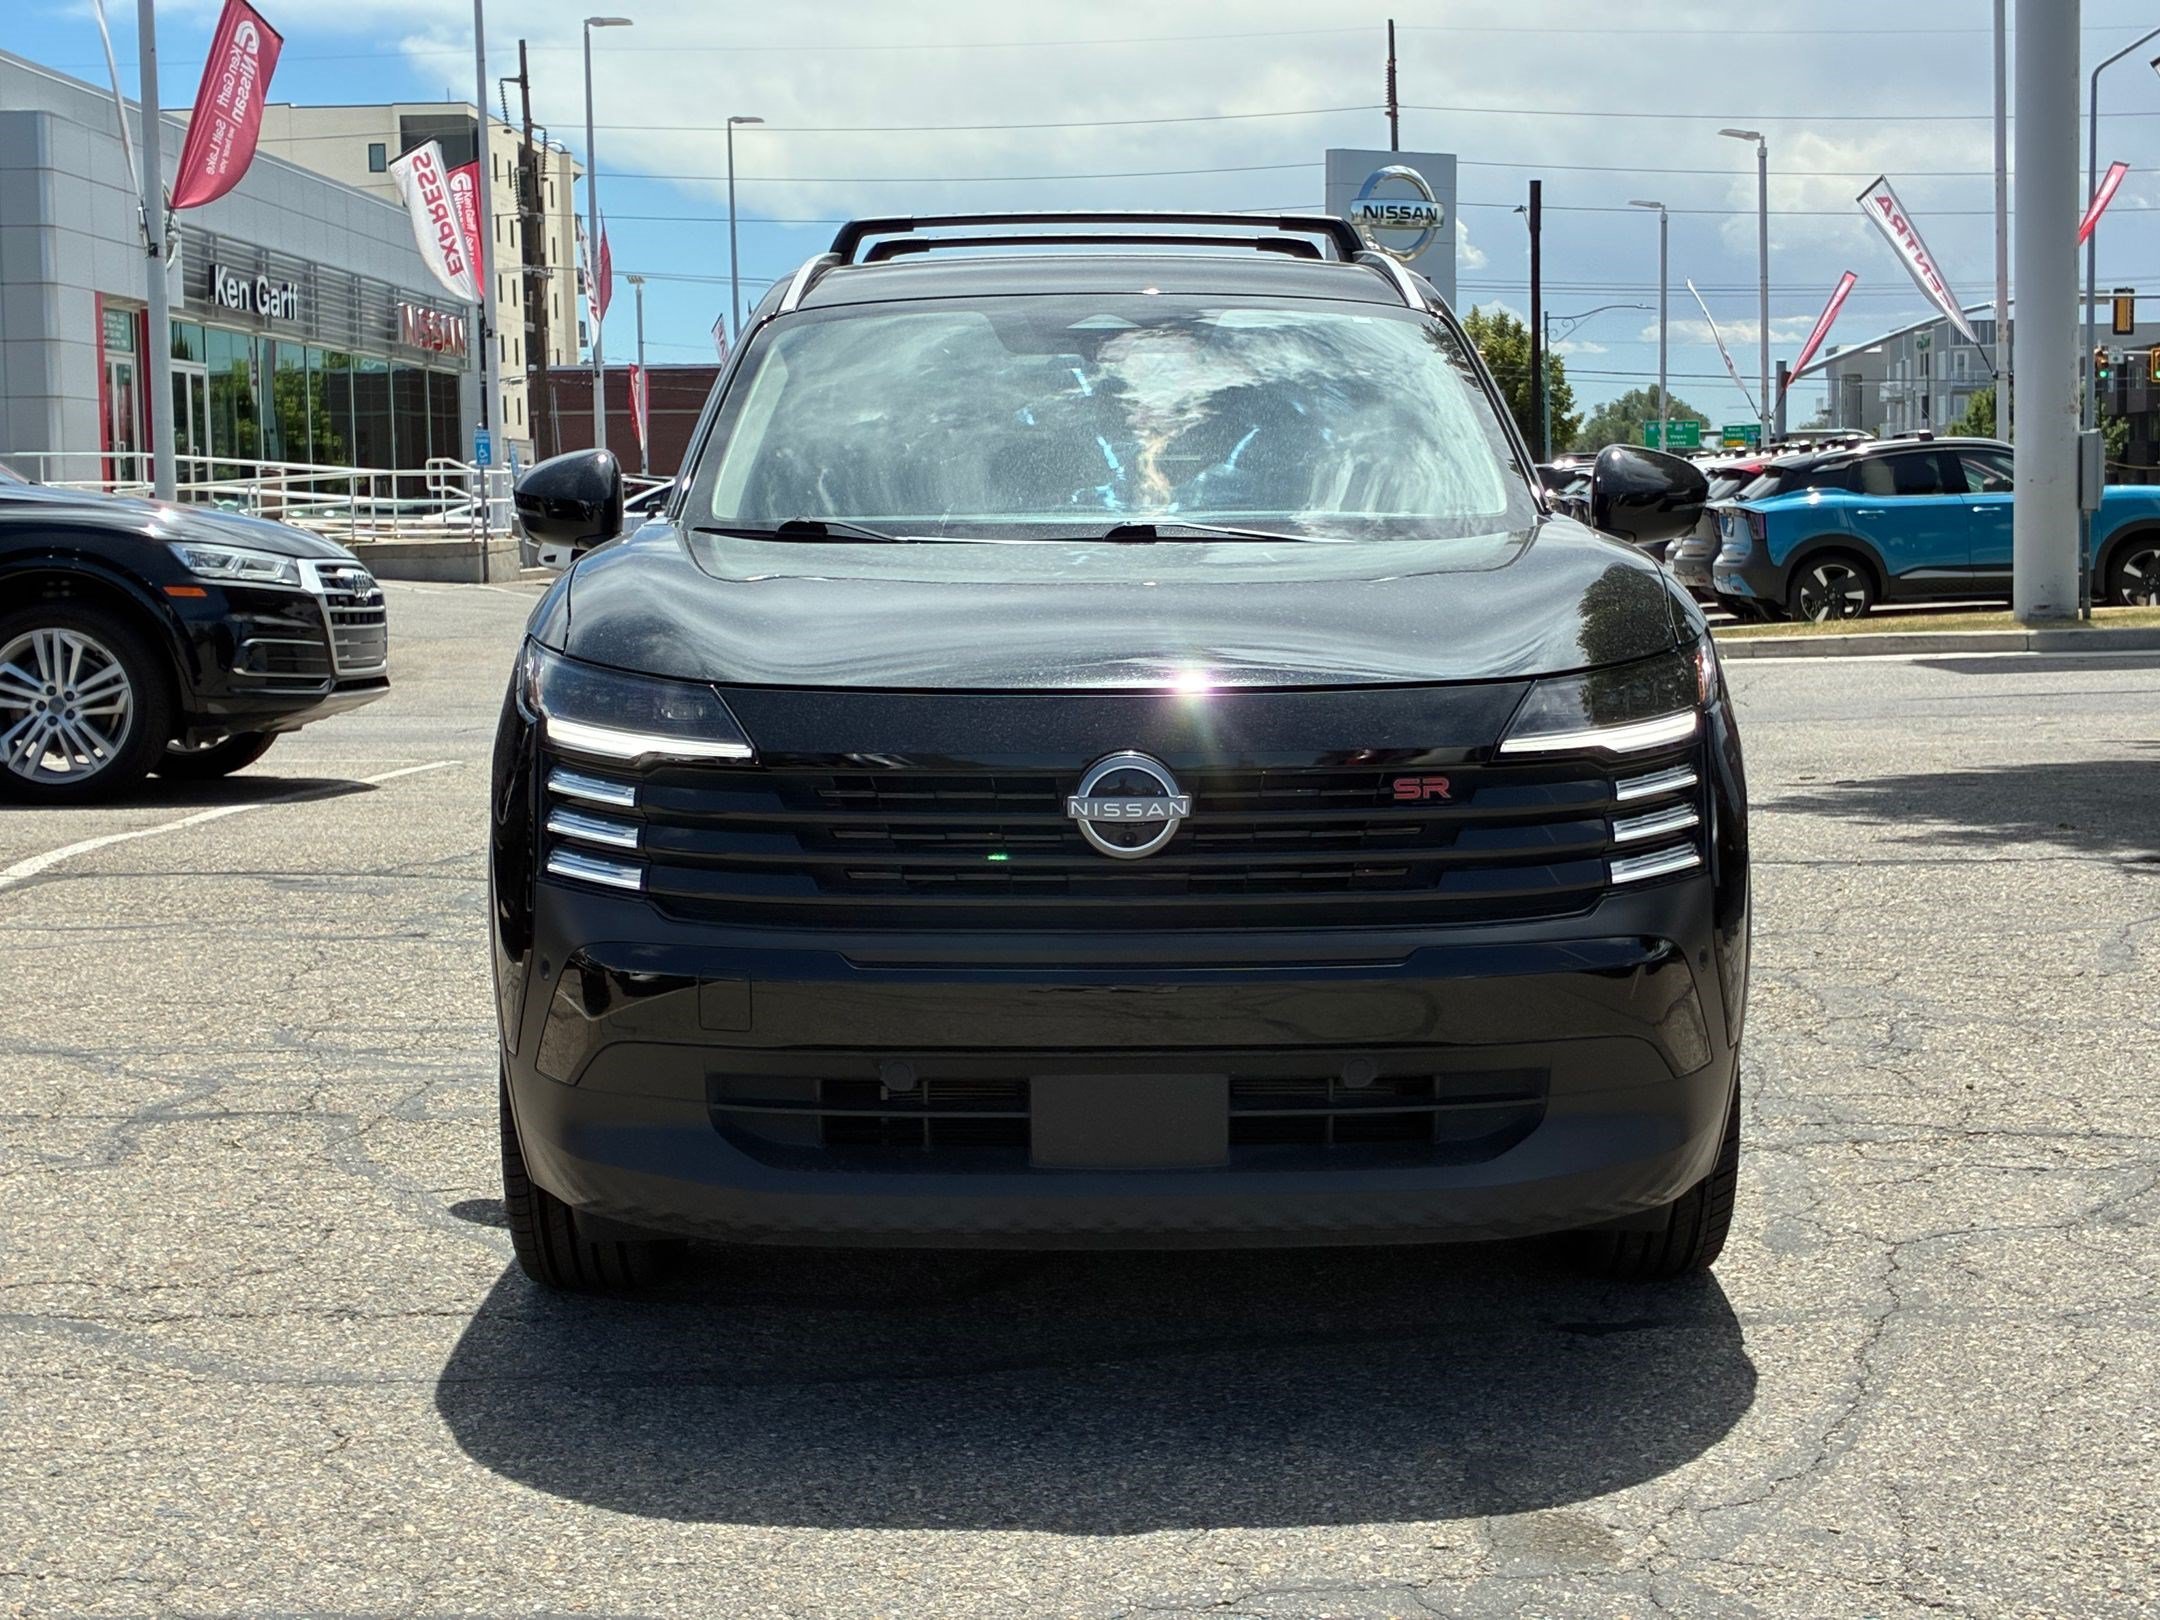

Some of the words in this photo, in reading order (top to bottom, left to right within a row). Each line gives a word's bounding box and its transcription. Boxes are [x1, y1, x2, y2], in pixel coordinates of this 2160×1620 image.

[1363, 204, 1438, 222] NISSAN
[214, 264, 250, 311] Ken
[256, 275, 298, 321] Garff
[397, 302, 466, 357] NISSAN
[1393, 778, 1452, 800] SR
[1069, 799, 1188, 819] NISSAN
